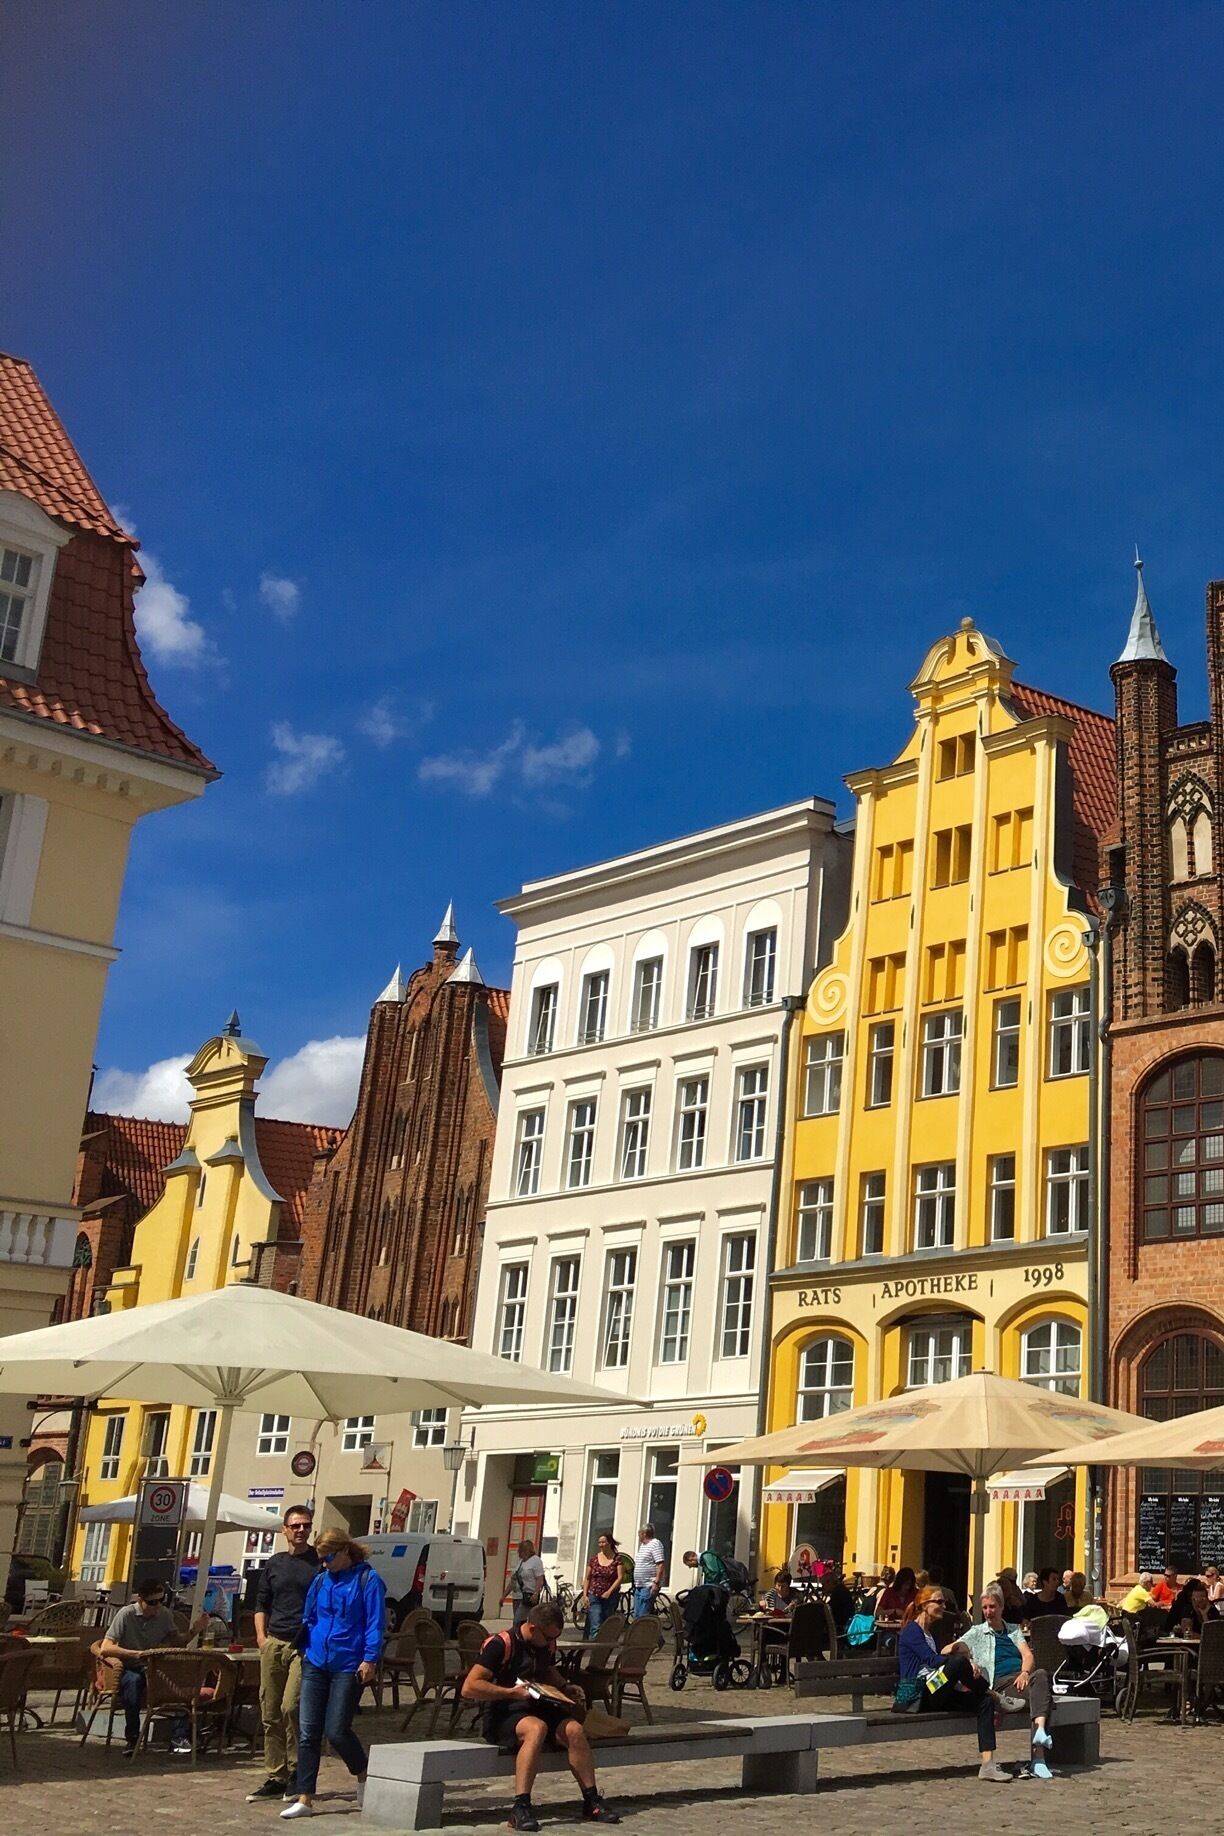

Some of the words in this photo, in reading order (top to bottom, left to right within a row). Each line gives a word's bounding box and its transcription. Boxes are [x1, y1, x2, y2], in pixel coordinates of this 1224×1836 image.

[798, 1288, 842, 1307] RATS
[881, 1274, 979, 1299] APOTHEKE
[1024, 1262, 1065, 1288] 1998
[155, 1493, 171, 1507] 30
[151, 1514, 171, 1523] ZONE
